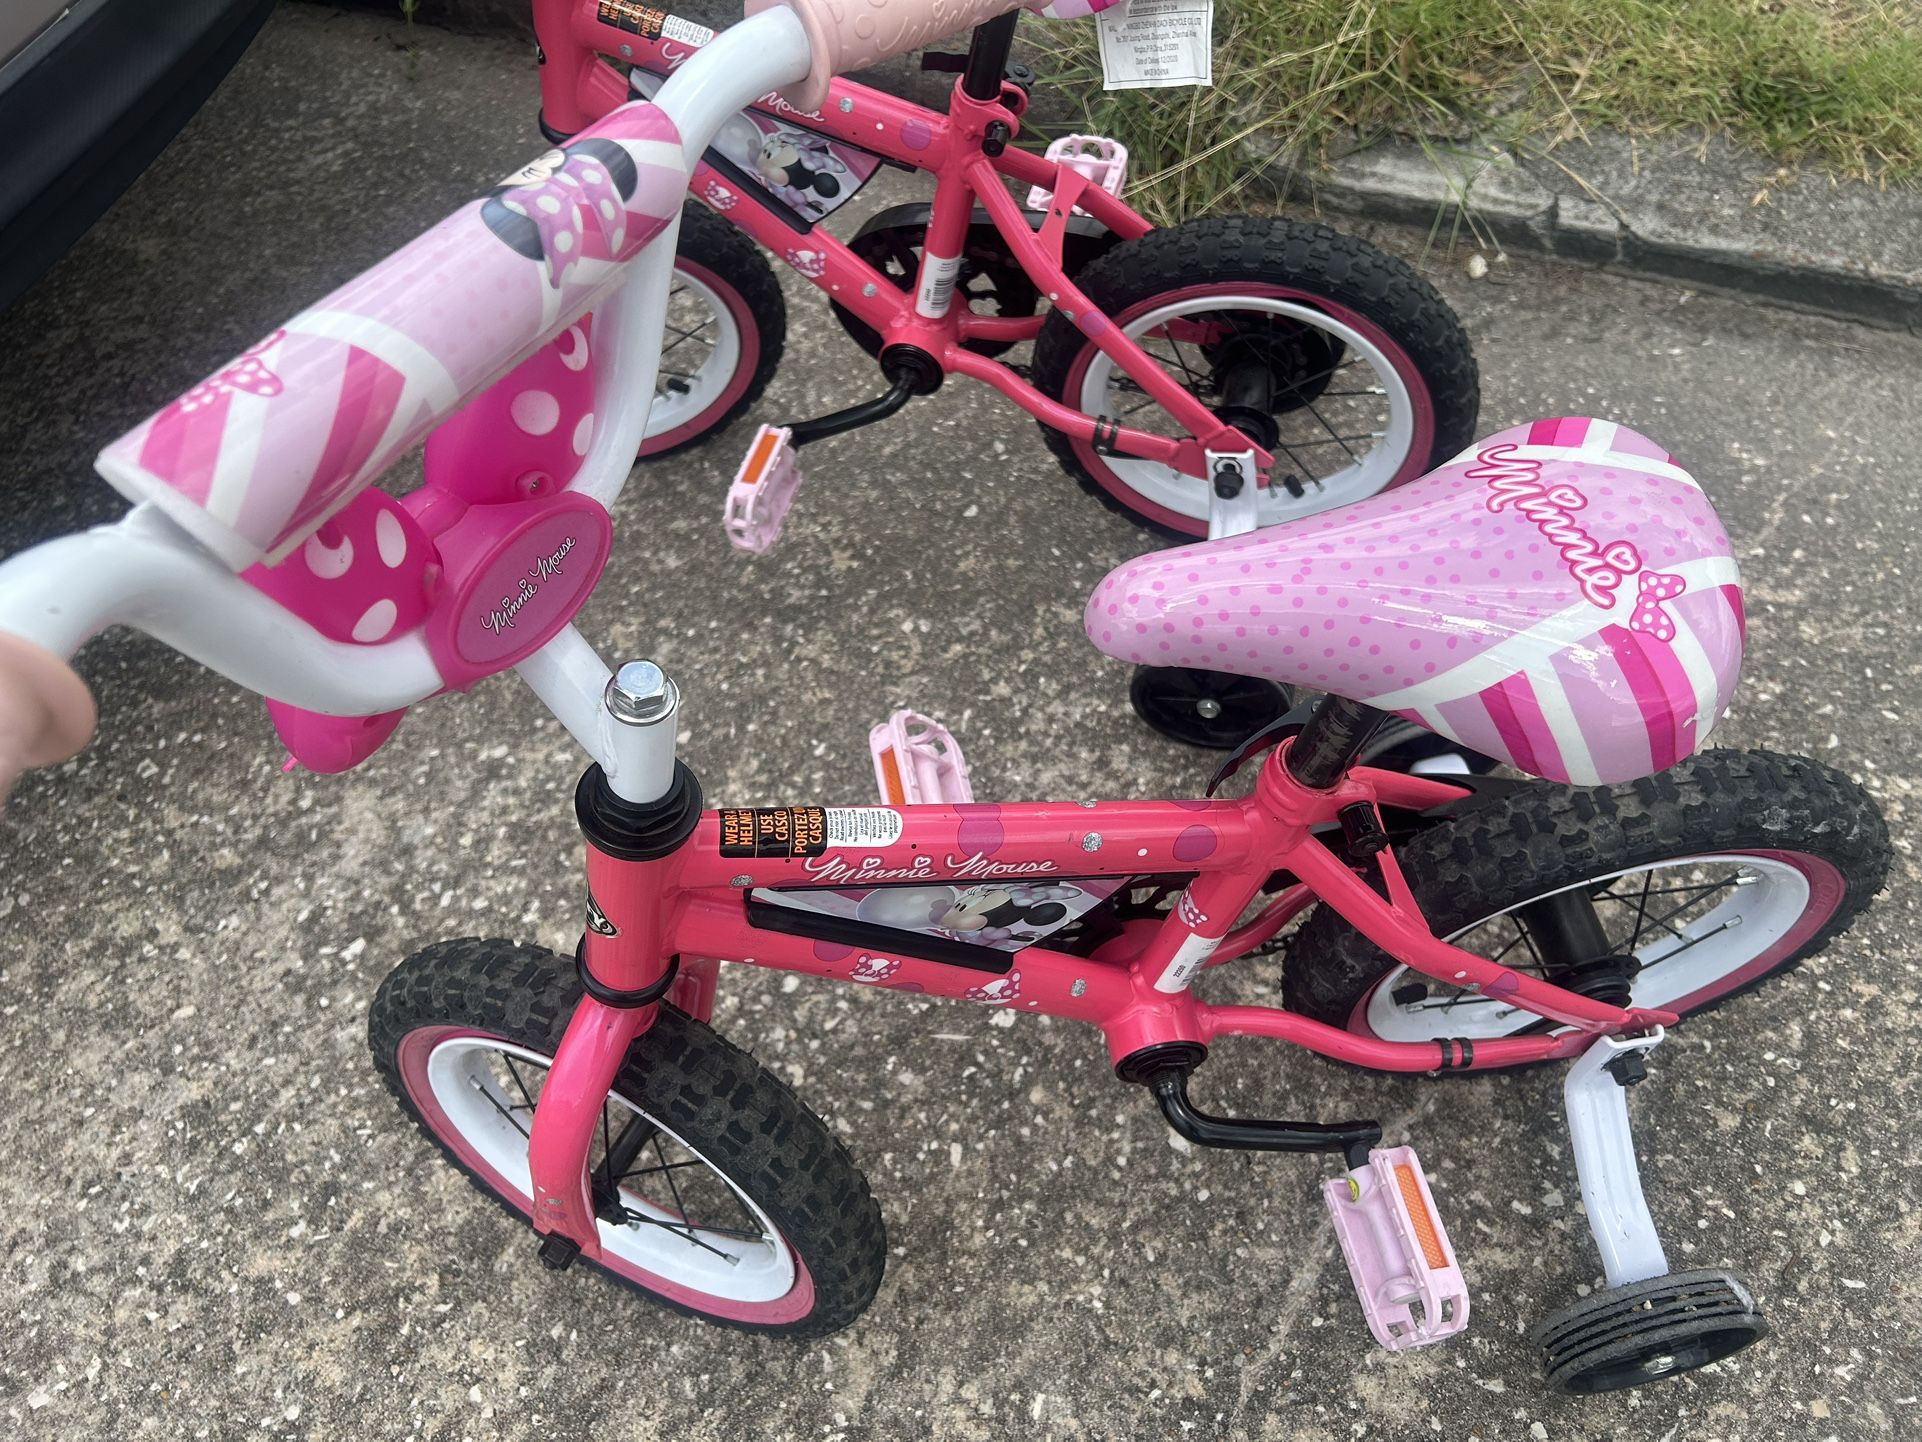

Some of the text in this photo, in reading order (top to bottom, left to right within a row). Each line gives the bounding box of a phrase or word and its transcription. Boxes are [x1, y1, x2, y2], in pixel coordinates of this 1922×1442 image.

[1464, 440, 1643, 610] Minnie
[480, 536, 576, 636] Minnie Mouse
[724, 814, 739, 845] WEAR
[759, 814, 774, 834] USE
[773, 810, 789, 841] CASCO
[794, 813, 808, 854] PORTEZ
[804, 851, 1058, 885] Minnie Mouse
